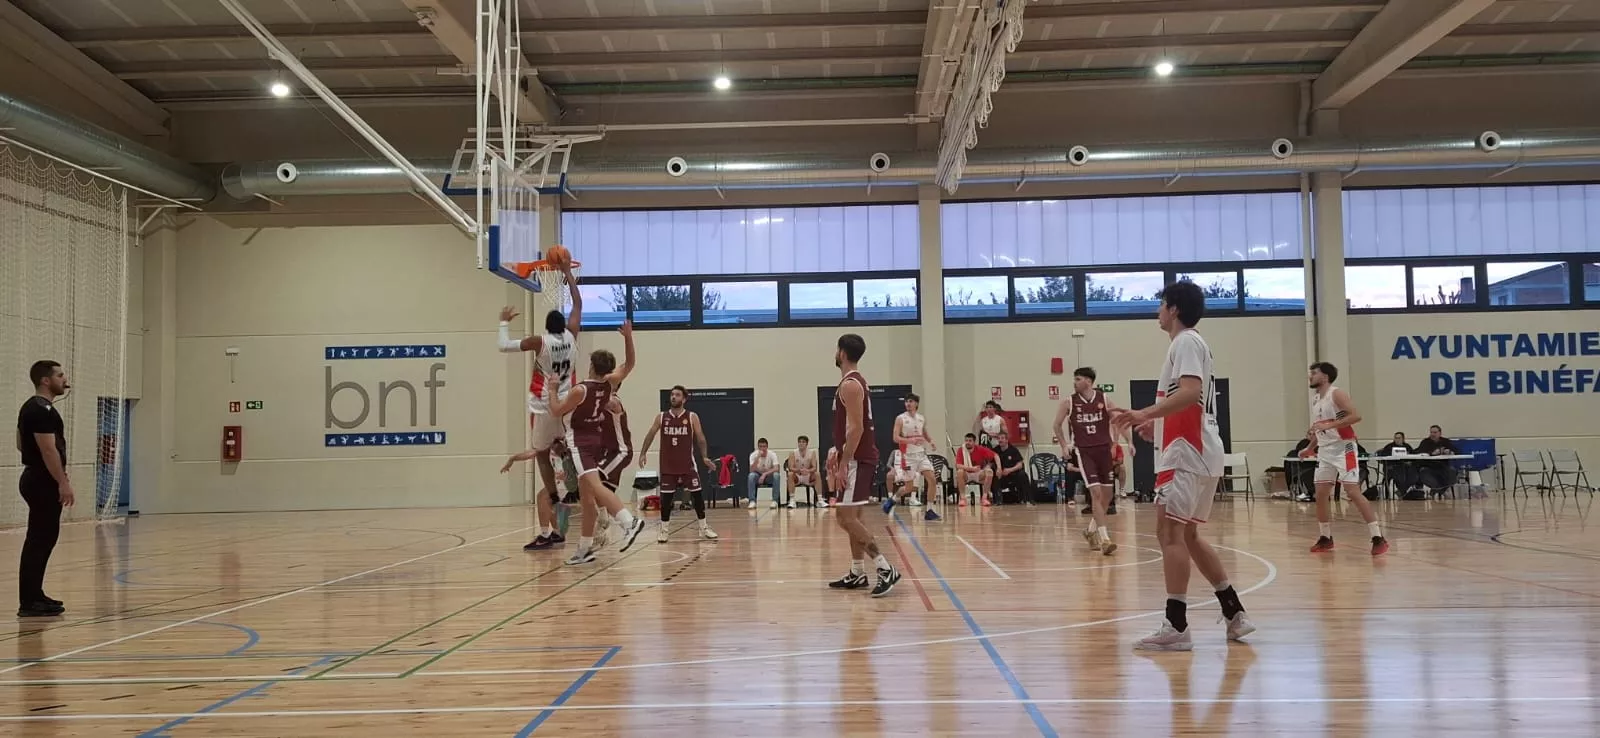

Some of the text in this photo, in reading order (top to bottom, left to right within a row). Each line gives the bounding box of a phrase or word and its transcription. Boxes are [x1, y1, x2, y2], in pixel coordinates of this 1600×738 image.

[325, 363, 446, 429] bnf
[1430, 371, 1476, 396] DE
[672, 437, 678, 446] 5
